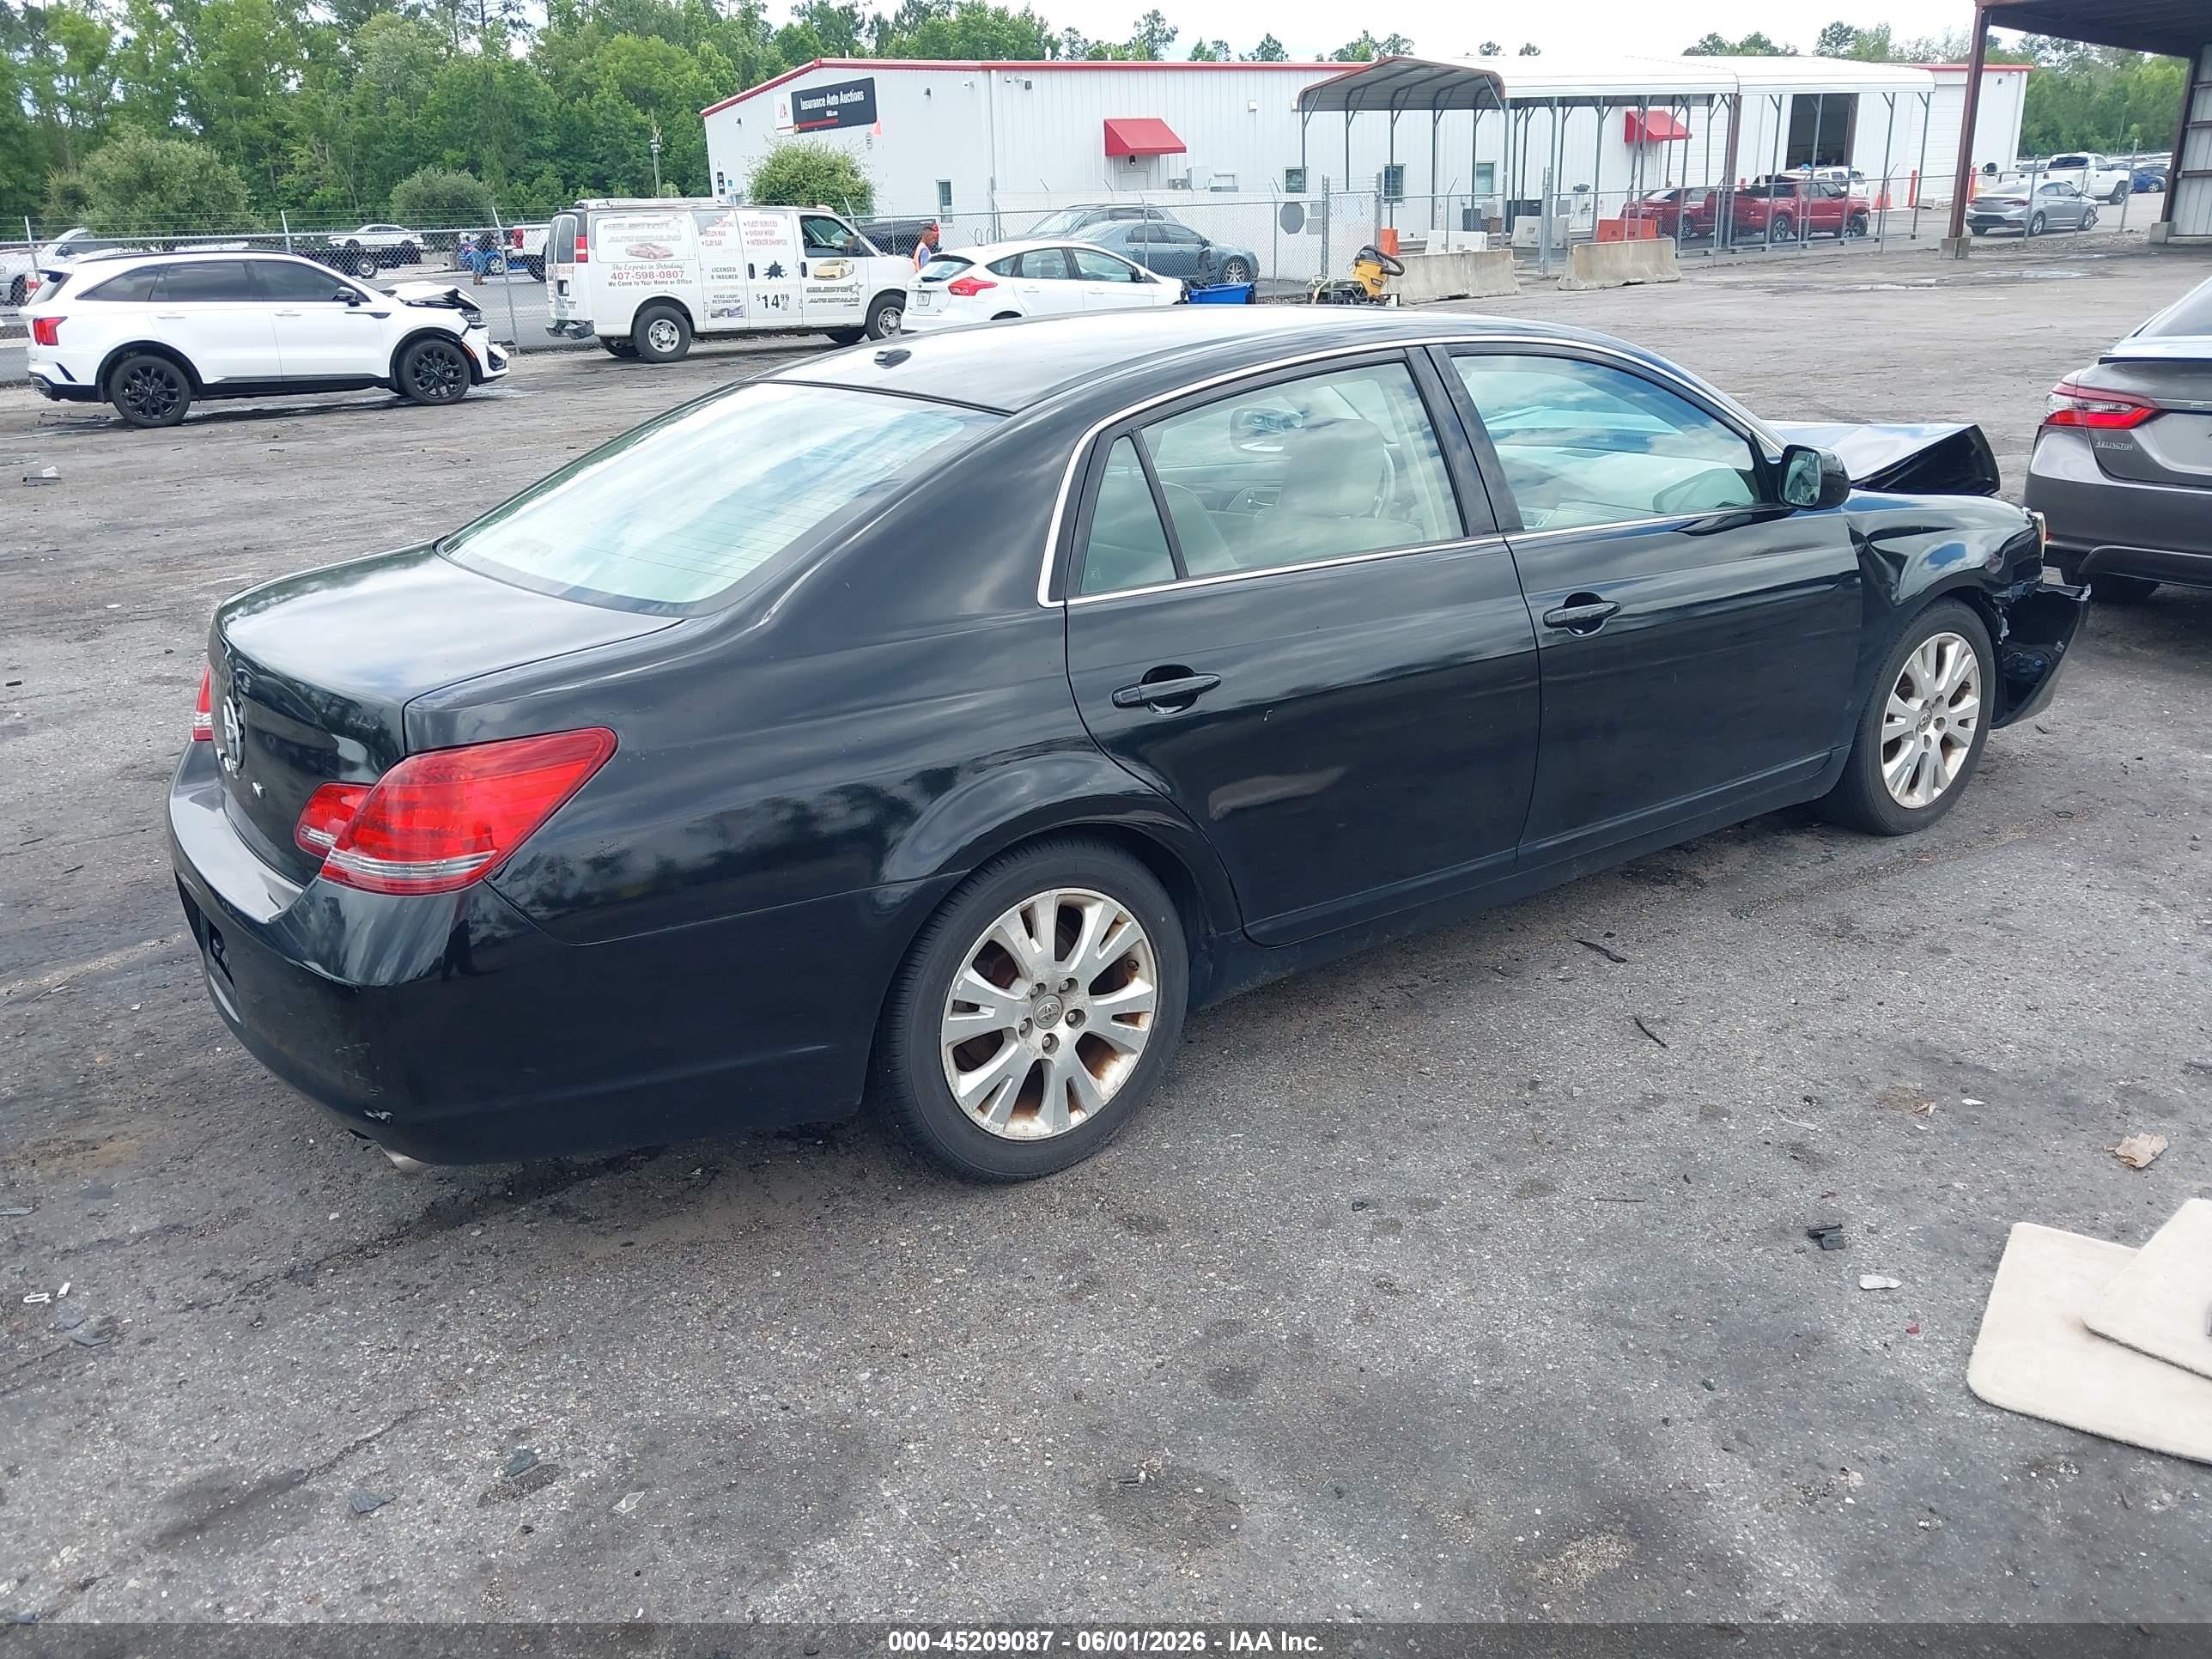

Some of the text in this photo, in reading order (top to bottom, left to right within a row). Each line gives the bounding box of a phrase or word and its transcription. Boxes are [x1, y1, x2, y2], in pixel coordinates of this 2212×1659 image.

[800, 88, 865, 111] Insurance Auto Auctions
[611, 270, 685, 280] 407-598-0807
